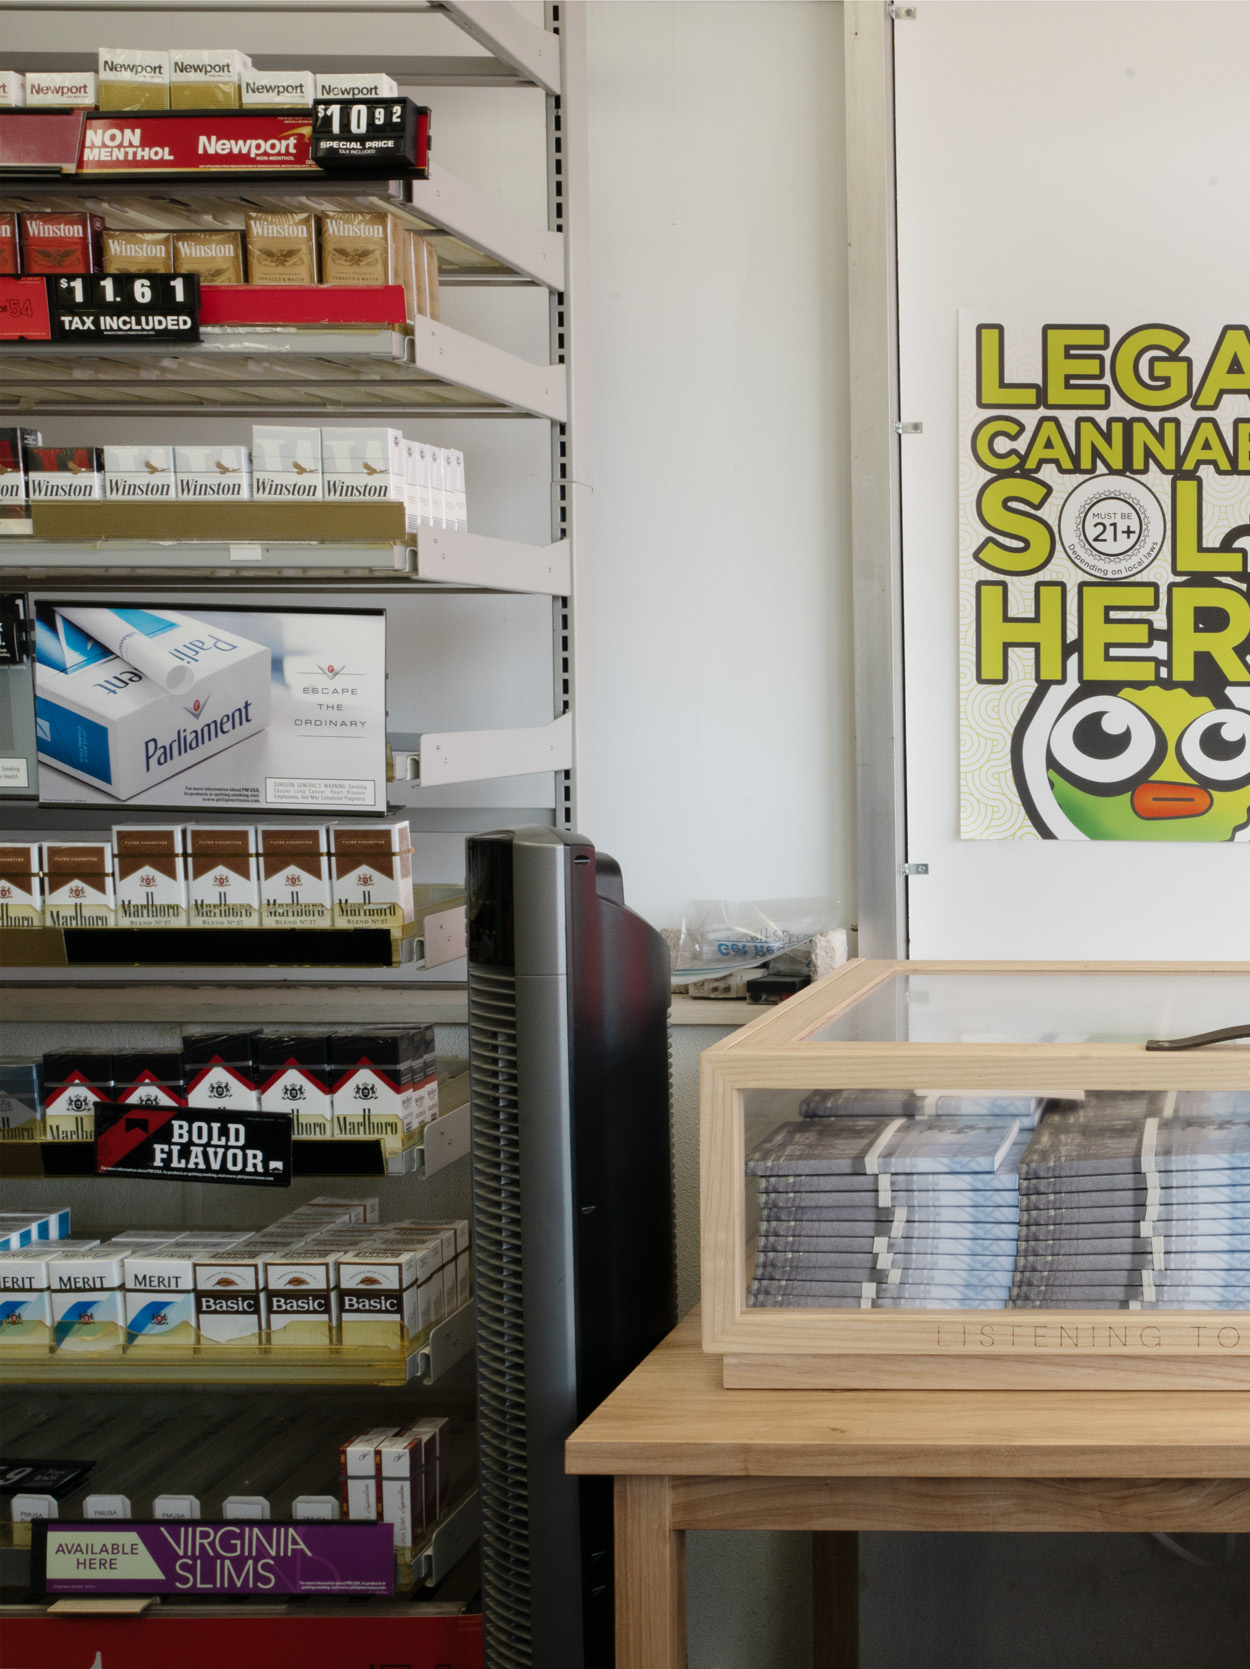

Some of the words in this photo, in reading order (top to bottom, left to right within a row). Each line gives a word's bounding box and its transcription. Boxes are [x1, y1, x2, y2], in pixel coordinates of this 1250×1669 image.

[103, 60, 163, 75] Newport
[174, 61, 231, 76] Newport
[30, 83, 88, 97] Newport
[246, 82, 304, 95] Newport
[321, 84, 379, 98] Newport
[85, 129, 141, 147] NON
[198, 135, 297, 158] Newport
[320, 141, 362, 149] SPECIAL
[365, 140, 394, 148] PRICE
[83, 147, 174, 161] MENTHOL
[26, 220, 84, 238] Winston
[250, 219, 307, 238] Winston
[326, 219, 383, 237] Winston
[108, 239, 166, 257] Winston
[179, 241, 234, 258] Winston
[61, 316, 95, 330] TAX
[100, 316, 192, 330] INCLUDED
[32, 479, 93, 497] Winston
[109, 478, 171, 496] Winston
[179, 478, 242, 496] Winston
[256, 478, 318, 497] Winston
[326, 480, 388, 498] Winston
[1092, 512, 1117, 520] MUST
[1120, 512, 1132, 520] BE
[1092, 522, 1136, 542] 21+
[1068, 543, 1108, 576] Depending
[1125, 558, 1145, 573] local
[1146, 541, 1158, 560] laws
[303, 687, 358, 696] ESCAPE
[317, 703, 344, 711] THE
[294, 719, 368, 728] ORDINARY
[144, 699, 252, 773] Parliament
[121, 892, 180, 918] Marlboro
[194, 891, 252, 918] Marlboro
[266, 891, 324, 918] Marlboro
[50, 903, 108, 927] Marlboro
[336, 1108, 398, 1136] Marlboro
[172, 1120, 245, 1146] BOLD
[153, 1144, 264, 1173] FLAVOR
[59, 1276, 106, 1289] MERIT
[134, 1274, 182, 1289] MERIT
[201, 1297, 254, 1311] Basic
[272, 1297, 325, 1311] Basic
[344, 1296, 398, 1311] Basic
[937, 1325, 1161, 1348] LISTENING
[1190, 1326, 1240, 1348] TO
[55, 1543, 139, 1555] AVAILABLE
[160, 1527, 312, 1557] VIRGINIA
[76, 1558, 118, 1570] HERE
[175, 1559, 275, 1589] SLIMS
